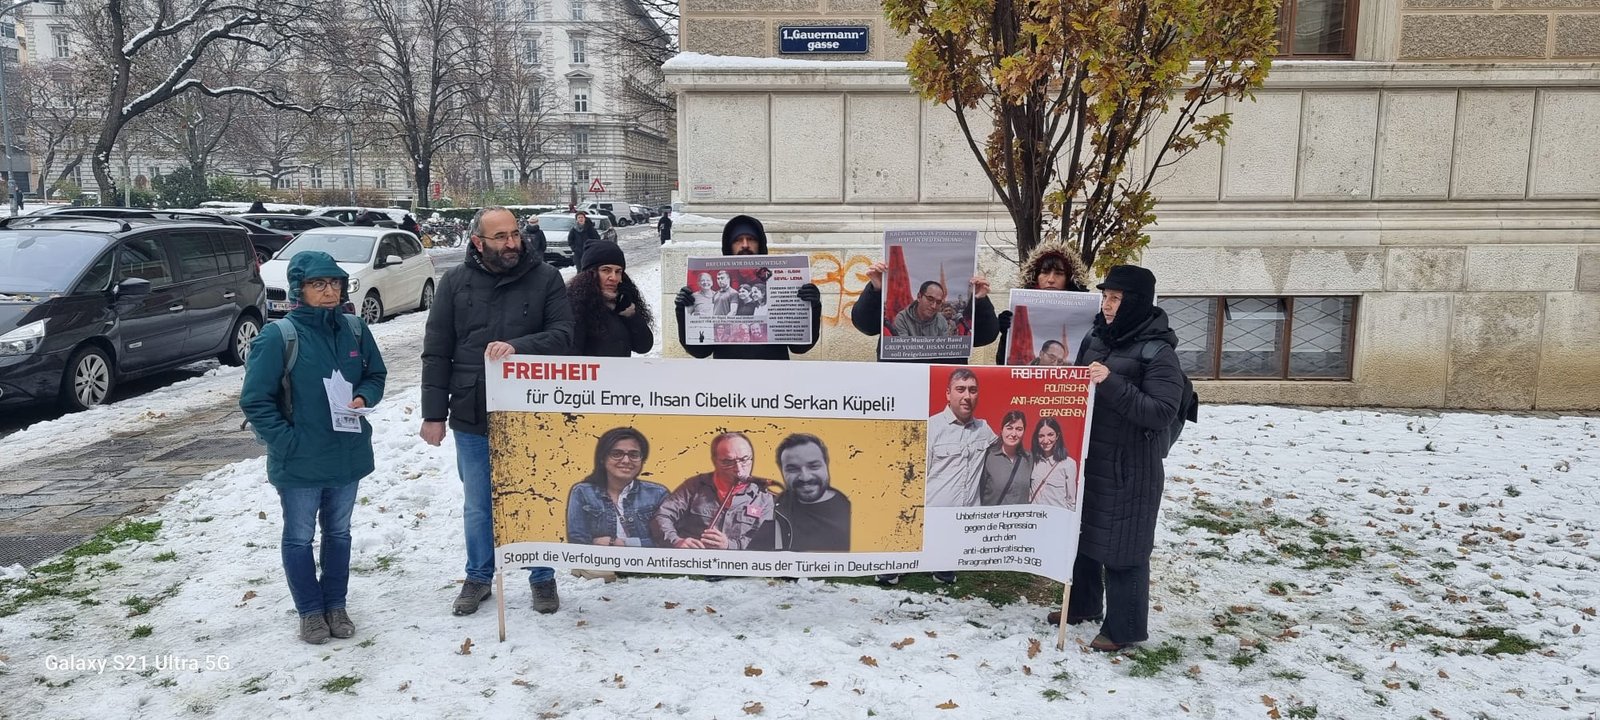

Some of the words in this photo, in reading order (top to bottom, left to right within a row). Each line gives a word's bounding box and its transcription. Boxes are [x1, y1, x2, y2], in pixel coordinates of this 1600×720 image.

[807, 42, 840, 51] gasse
[502, 362, 600, 381] FREIHEIT
[1011, 368, 1048, 379] FREIHEIT
[1050, 366, 1068, 379] FÜR
[1068, 369, 1090, 379] ALLE
[1044, 384, 1089, 392] POLITISCHEN
[526, 388, 549, 404] für
[554, 387, 596, 409] Özgül
[601, 390, 644, 408] Emre,
[650, 392, 690, 407] Ihsan
[695, 393, 746, 408] Cibelik
[751, 394, 778, 409] und
[784, 394, 838, 410] Serkan
[843, 396, 895, 414] Küpeli!
[1040, 408, 1085, 418] GEFANGENEN
[956, 511, 1001, 520] Unbefristeter
[1002, 510, 1048, 519] Hungerstreik
[964, 524, 985, 533] gegen
[998, 522, 1037, 531] Repression
[963, 545, 1035, 554] anti-demokratischen
[504, 551, 539, 564] Stoppt
[543, 551, 559, 562] die
[562, 552, 621, 568] Verfolgung
[624, 557, 644, 566] von
[751, 561, 772, 571] aus
[774, 560, 793, 571] der
[796, 560, 830, 572] Türkei
[834, 561, 844, 572] in
[848, 560, 919, 572] Deutschland!
[958, 557, 1002, 567] Paragraphen
